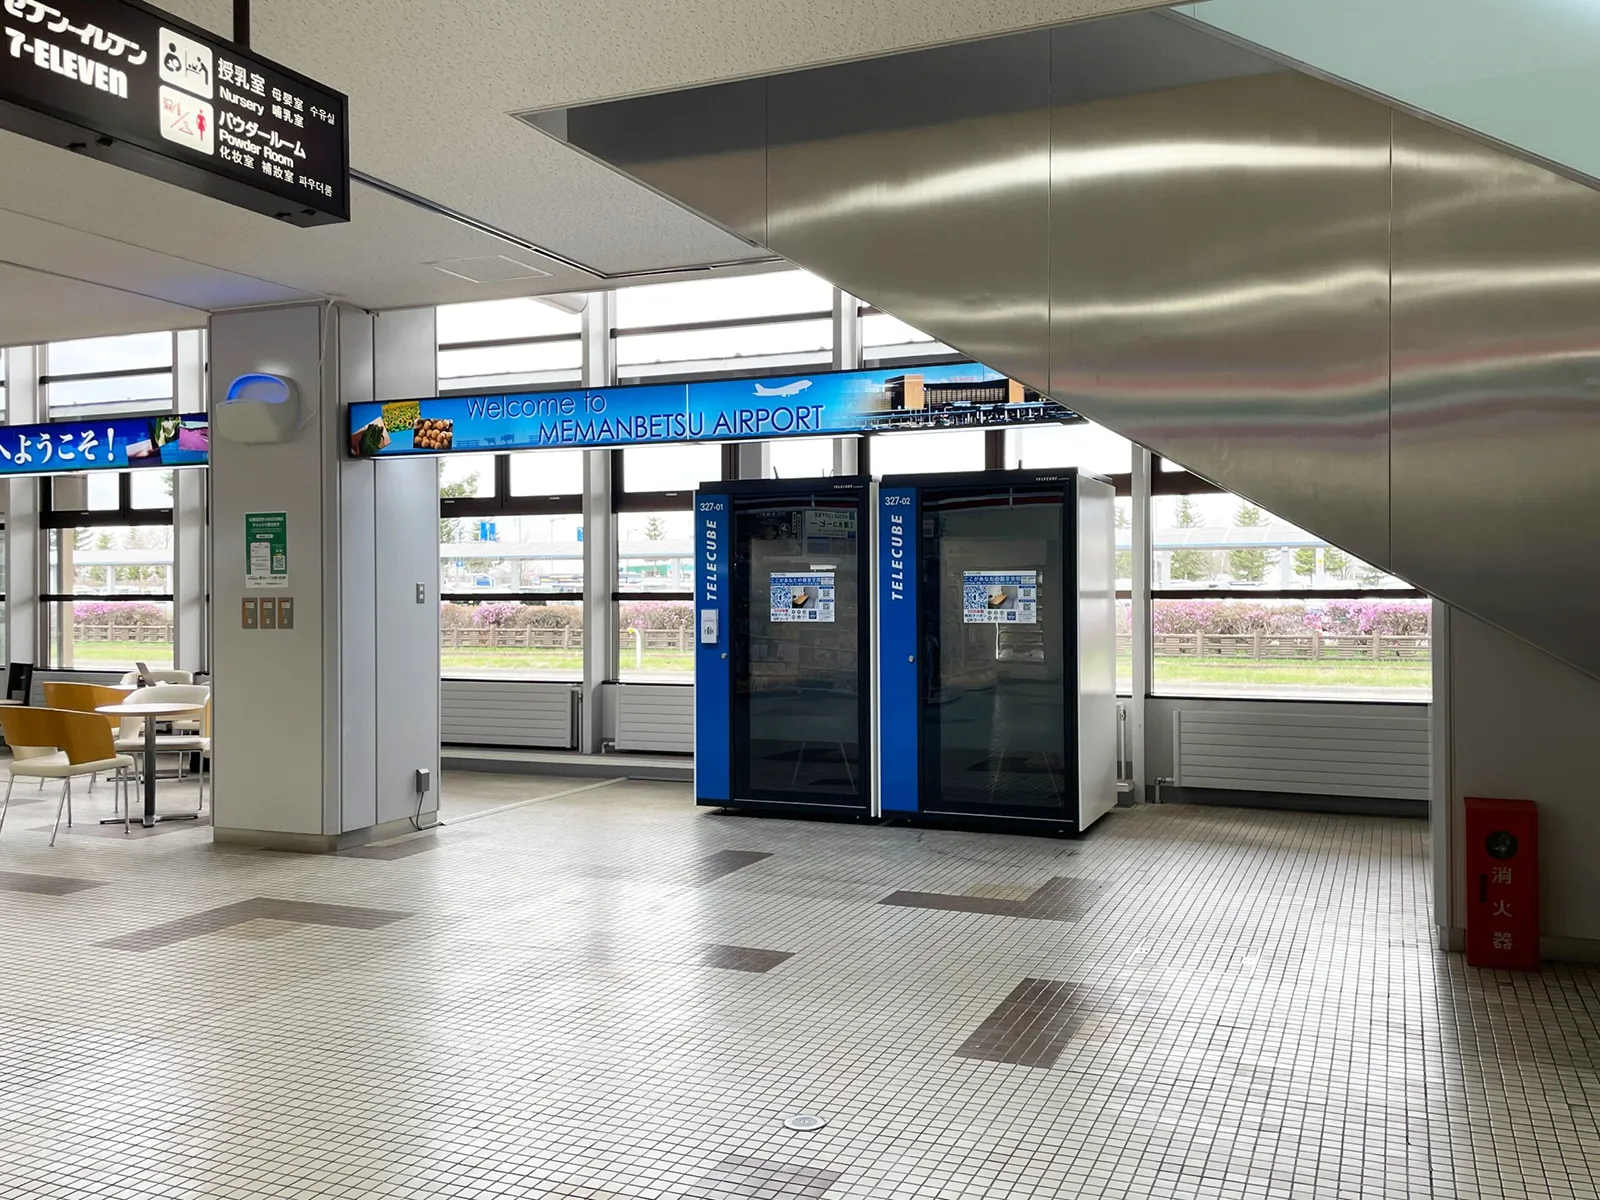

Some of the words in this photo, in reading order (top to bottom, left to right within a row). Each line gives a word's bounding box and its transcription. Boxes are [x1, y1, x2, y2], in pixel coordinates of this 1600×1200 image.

[218, 57, 266, 97] 授乳室
[309, 105, 335, 126] 수유실
[219, 85, 265, 116] Nursery
[271, 104, 304, 128] 哺乳室
[219, 110, 307, 159] パウダールーム
[219, 128, 262, 156] Powder
[263, 146, 294, 168] Room
[299, 175, 333, 197] 파우더룸
[466, 395, 575, 420] Welcome
[583, 391, 607, 414] to
[538, 411, 703, 444] MEMANBETSU
[712, 405, 824, 436] AIRPORT
[700, 502, 724, 512] 327-01
[885, 497, 911, 506] 327-02
[706, 519, 718, 601] TELECUBE
[891, 515, 903, 601] TELECUBE
[1491, 866, 1513, 951] 消火器
